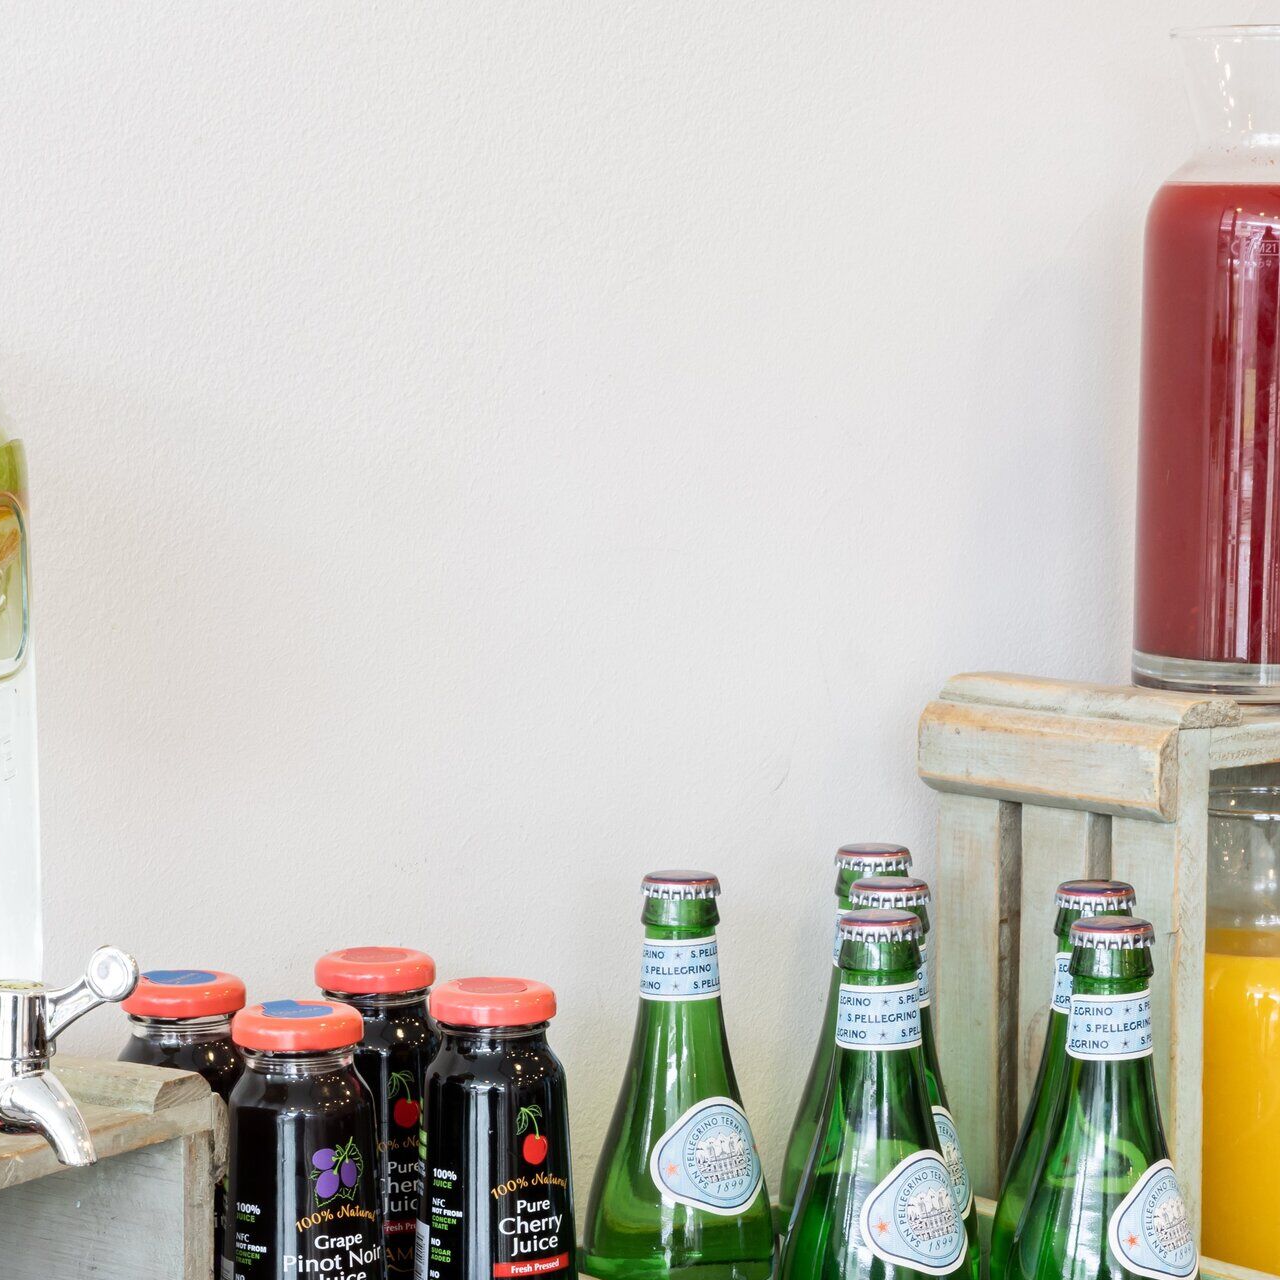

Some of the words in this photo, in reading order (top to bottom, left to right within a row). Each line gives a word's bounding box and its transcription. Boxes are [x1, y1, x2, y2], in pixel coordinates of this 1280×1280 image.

[686, 1117, 718, 1167] PELLEGRINO
[490, 1176, 528, 1200] 100%
[692, 1171, 709, 1189] SAN
[717, 1179, 744, 1193] 1899
[517, 1200, 550, 1213] Pure
[897, 1171, 928, 1225] PELLEGRINO
[295, 1209, 334, 1232] 100%
[337, 1203, 376, 1222] Natural
[1146, 1182, 1167, 1237] PELLEGRINO
[498, 1214, 562, 1235] Cherry
[314, 1233, 362, 1250] Grape
[511, 1235, 558, 1256] Juice
[903, 1228, 920, 1248] SAN
[929, 1237, 954, 1252] 1899
[283, 1254, 342, 1272] Pinot
[349, 1244, 381, 1268] Noir
[1152, 1240, 1168, 1258] SAN
[511, 1265, 532, 1273] Fresh
[534, 1259, 560, 1271] Pressed
